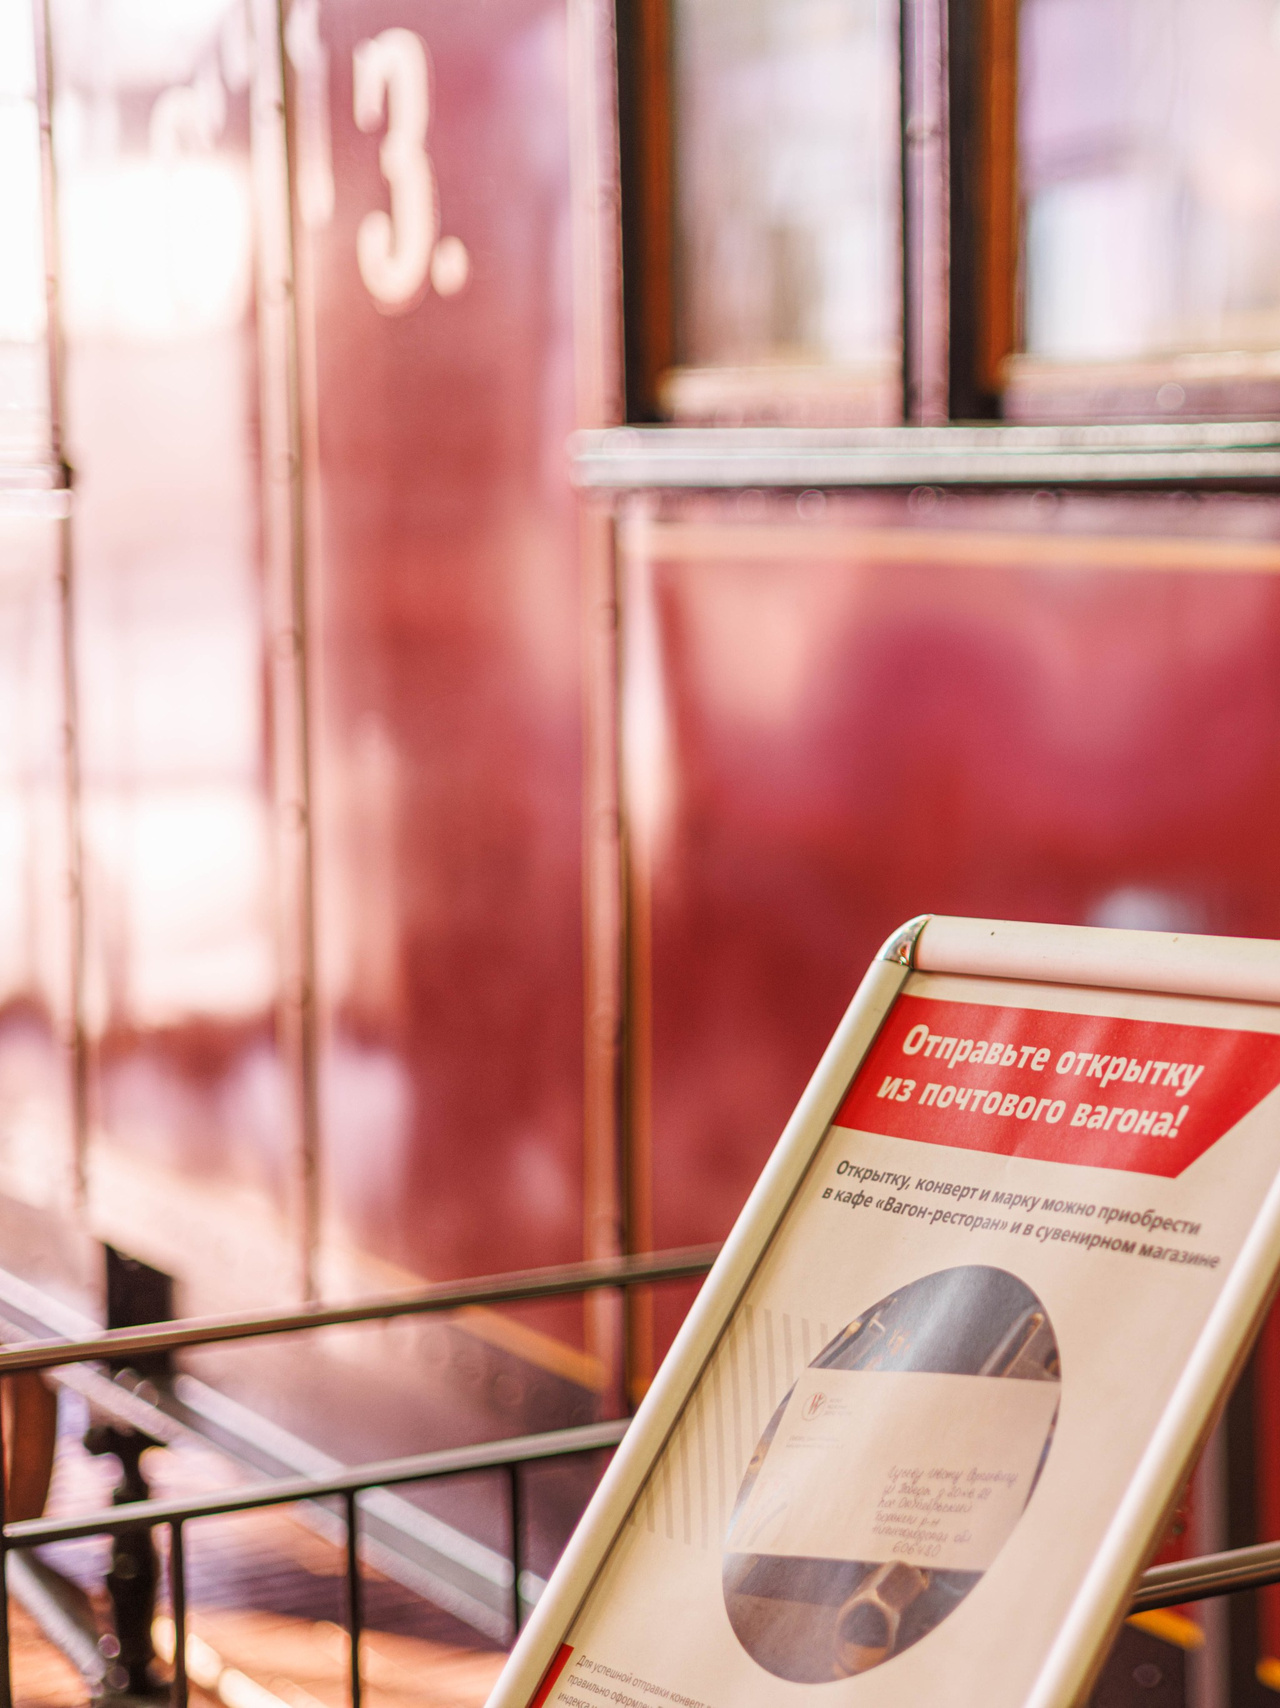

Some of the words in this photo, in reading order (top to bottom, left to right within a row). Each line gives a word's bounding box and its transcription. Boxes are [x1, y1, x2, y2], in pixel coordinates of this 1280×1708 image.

[902, 1024, 1052, 1070] Отправьте
[1055, 1050, 1204, 1097] открытку
[876, 1075, 917, 1102] из
[918, 1082, 1066, 1124] почтового
[1070, 1103, 1190, 1139] вагона!
[822, 1187, 833, 1200] в
[834, 1189, 873, 1209] кафе
[875, 1197, 1008, 1231] «Вагон-ресторан»
[1009, 1221, 1022, 1235] и
[1023, 1223, 1034, 1236] в
[1035, 1225, 1137, 1253] сувенирном
[1138, 1243, 1221, 1269] магазине
[836, 1160, 911, 1191] Открытку,
[915, 1178, 979, 1202] конверт
[978, 1188, 991, 1202] и
[990, 1190, 1041, 1212] марку
[1041, 1198, 1096, 1217] можно
[1097, 1206, 1201, 1236] приобрести
[567, 1674, 610, 1697] правильно
[576, 1655, 593, 1669] Для
[591, 1662, 632, 1685] успешной
[631, 1678, 670, 1698] отправки
